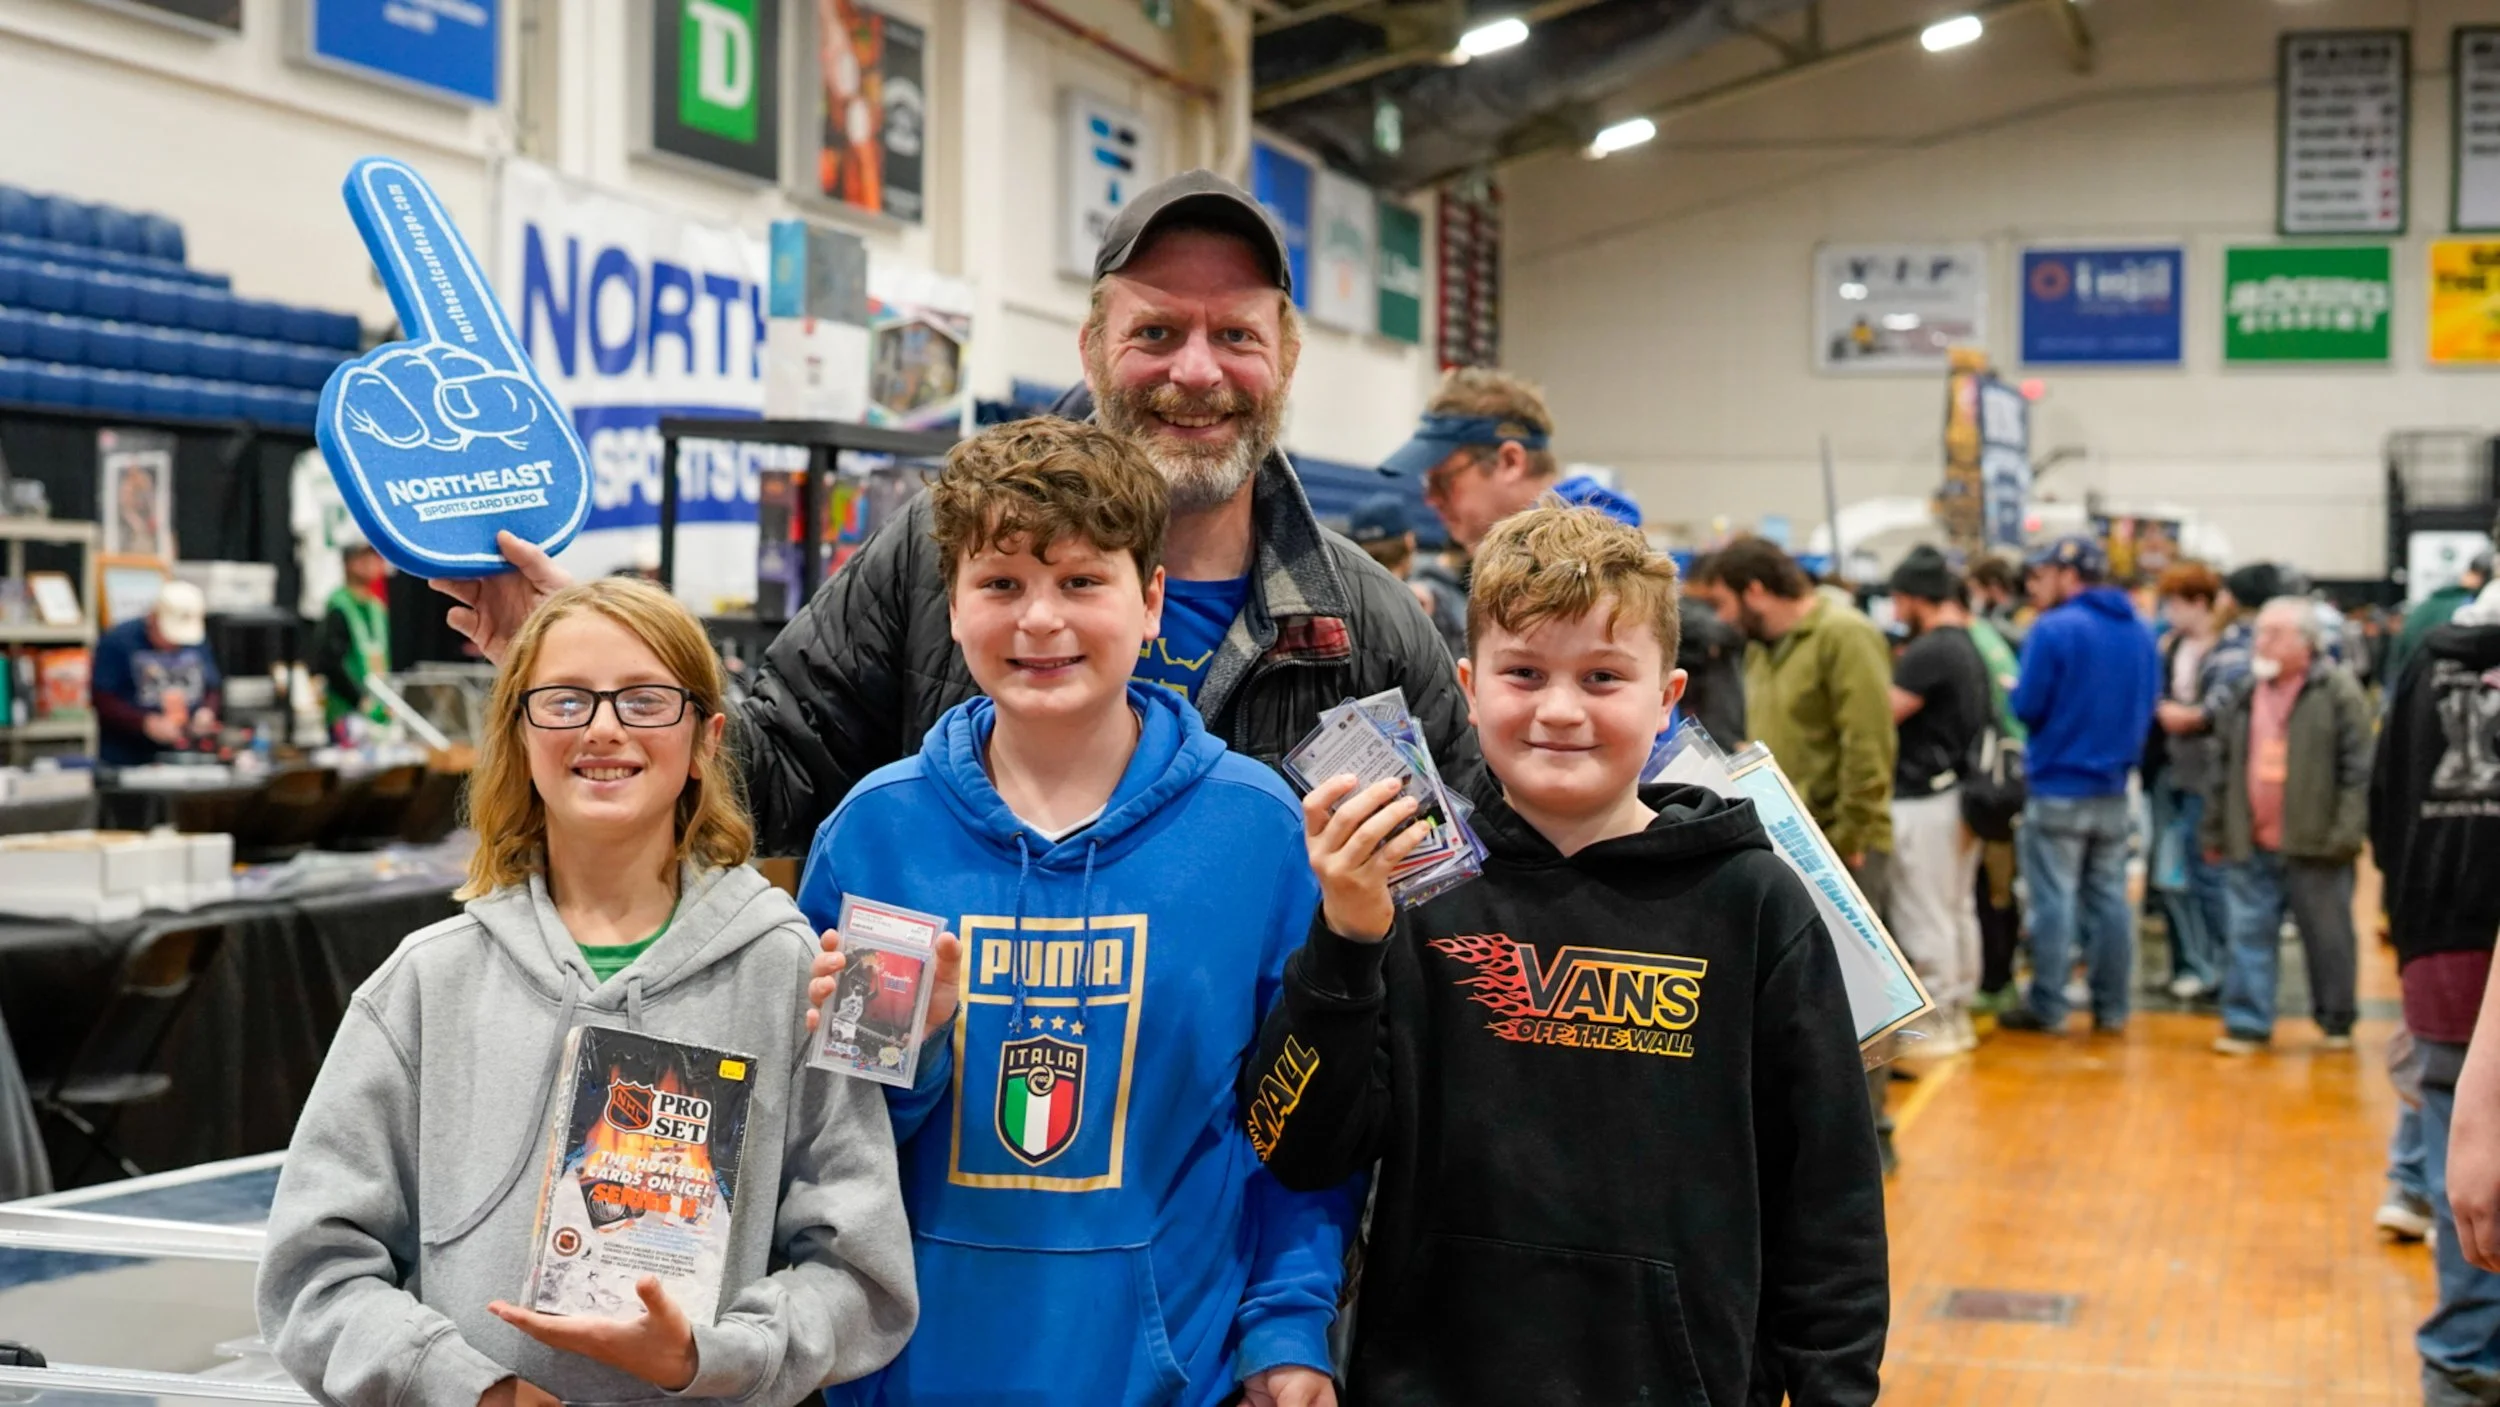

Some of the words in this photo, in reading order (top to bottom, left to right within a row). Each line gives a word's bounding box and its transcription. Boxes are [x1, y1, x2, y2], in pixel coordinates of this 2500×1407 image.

[387, 183, 479, 344] northeastcardexpo.com
[385, 460, 554, 507] NORTHEAST
[423, 502, 470, 517] SPORTS
[470, 497, 504, 511] CARD
[505, 492, 539, 506] EXPO
[980, 938, 1123, 988] PUMA
[1516, 944, 1709, 1031] VANS
[1515, 1018, 1568, 1044] OFF
[1571, 1024, 1623, 1050] THE
[1625, 1028, 1695, 1058] WALL
[1008, 1047, 1078, 1071] ITALIA
[615, 1088, 645, 1123] NHL
[658, 1093, 709, 1120] PRO
[653, 1117, 706, 1143] SET
[600, 1150, 632, 1169] THE
[587, 1165, 644, 1186] CARDS
[647, 1174, 675, 1192] ON
[678, 1182, 713, 1198] ICE!
[591, 1183, 673, 1213] SERIES
